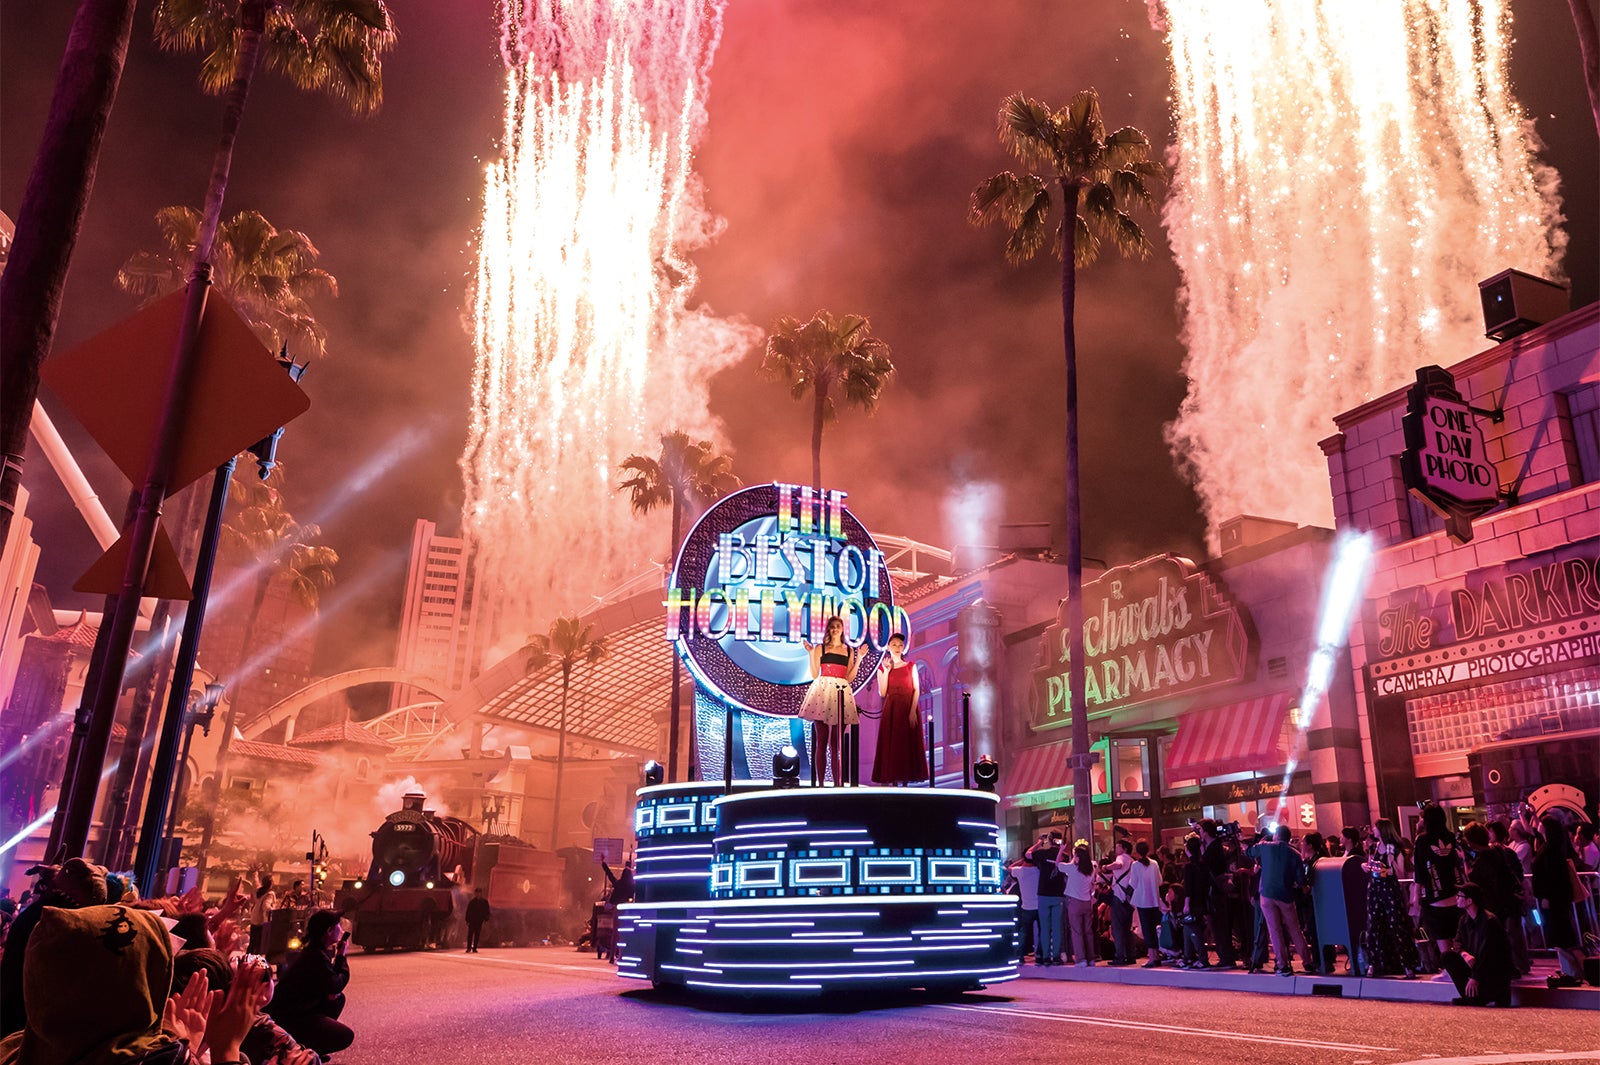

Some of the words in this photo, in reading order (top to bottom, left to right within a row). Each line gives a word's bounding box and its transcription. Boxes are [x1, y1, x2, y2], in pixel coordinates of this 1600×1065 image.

[1430, 406, 1471, 434] ONE
[1435, 431, 1472, 459] DAY
[1425, 454, 1491, 487] PHOTO
[773, 481, 848, 541] THE
[713, 533, 832, 590] BEST
[834, 545, 885, 598] OF
[662, 587, 912, 656] HOLLYWOOD
[1379, 601, 1433, 657] The
[1451, 556, 1600, 641] DARKR
[1467, 635, 1600, 680] PHOTOGRAPHI
[1120, 802, 1145, 817] Candy
